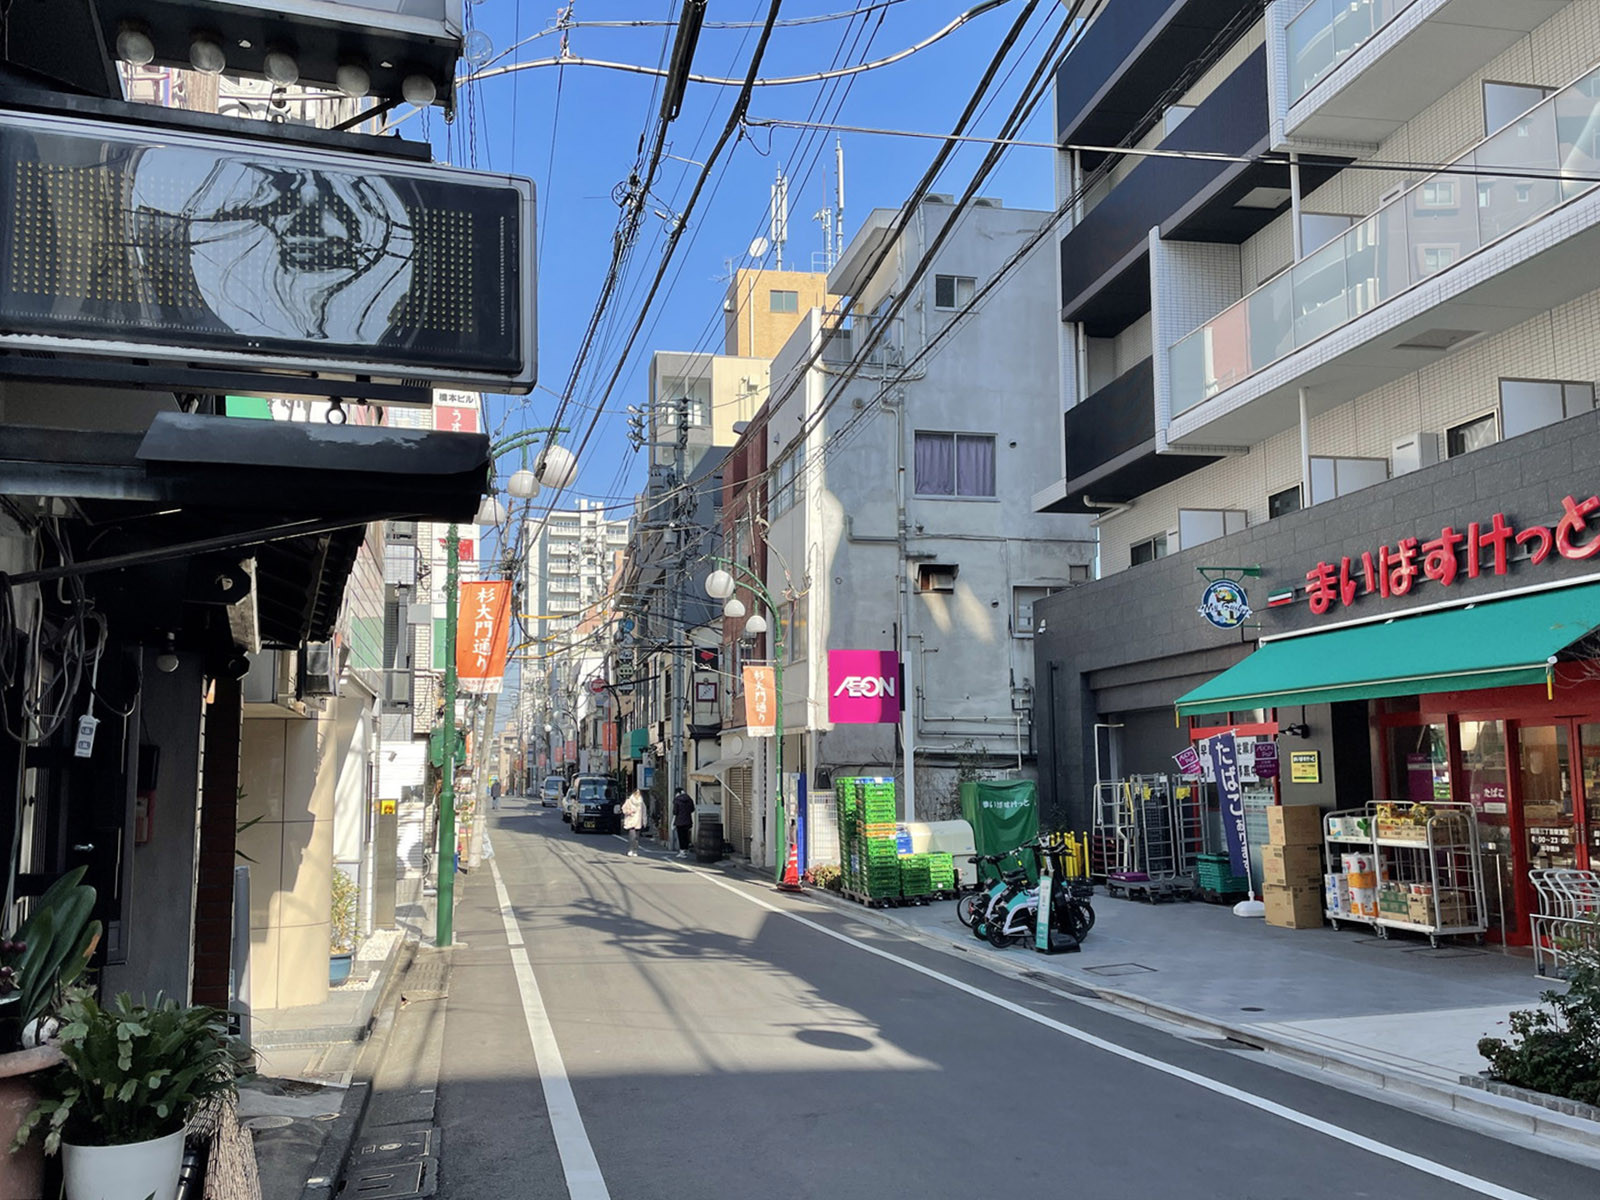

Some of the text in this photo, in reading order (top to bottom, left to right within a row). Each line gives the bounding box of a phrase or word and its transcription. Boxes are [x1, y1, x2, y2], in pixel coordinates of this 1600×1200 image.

[1305, 494, 1600, 615] まいばすけっと
[472, 586, 496, 673] 杉大門通り
[833, 676, 895, 698] AEON
[1483, 788, 1505, 798] たばこ
